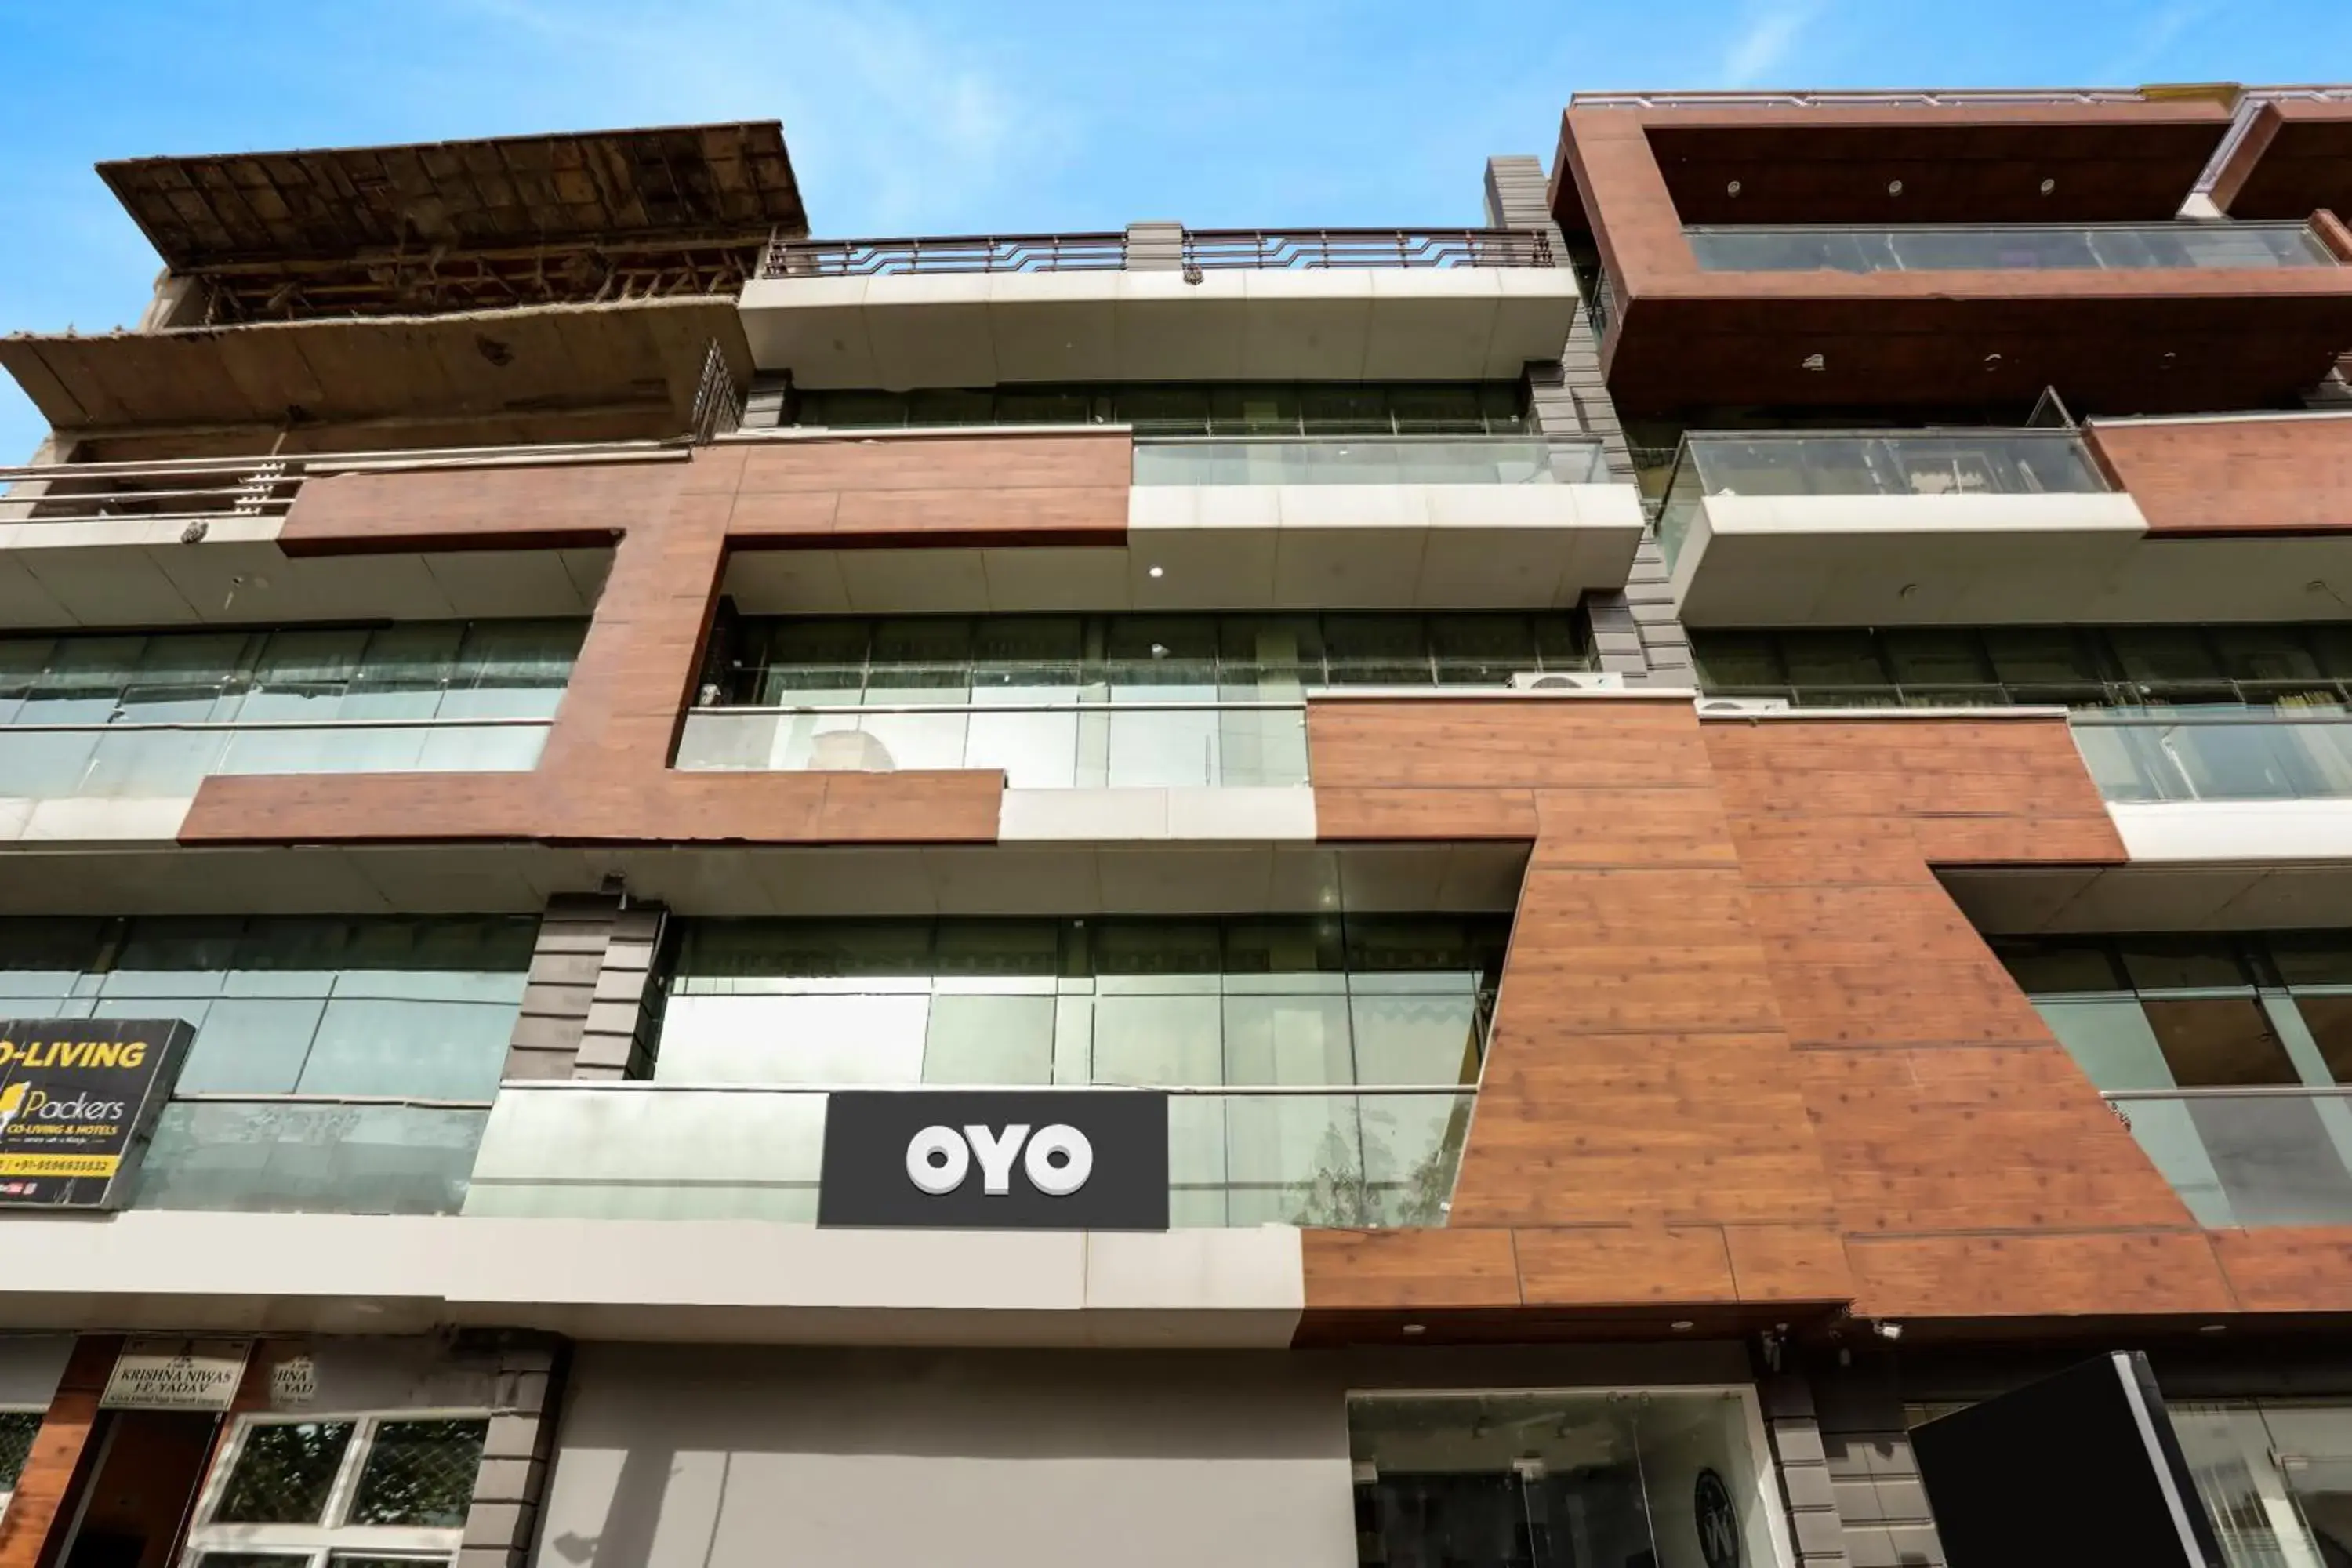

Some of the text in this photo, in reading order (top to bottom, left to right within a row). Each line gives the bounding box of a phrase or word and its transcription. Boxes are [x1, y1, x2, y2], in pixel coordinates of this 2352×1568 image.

[22, 1090, 125, 1120] Packers
[75, 1125, 119, 1136] HOTELS
[906, 1123, 1094, 1196] OYO
[121, 1369, 233, 1384] KRISHNA NIWAS
[159, 1382, 209, 1394] YADAV
